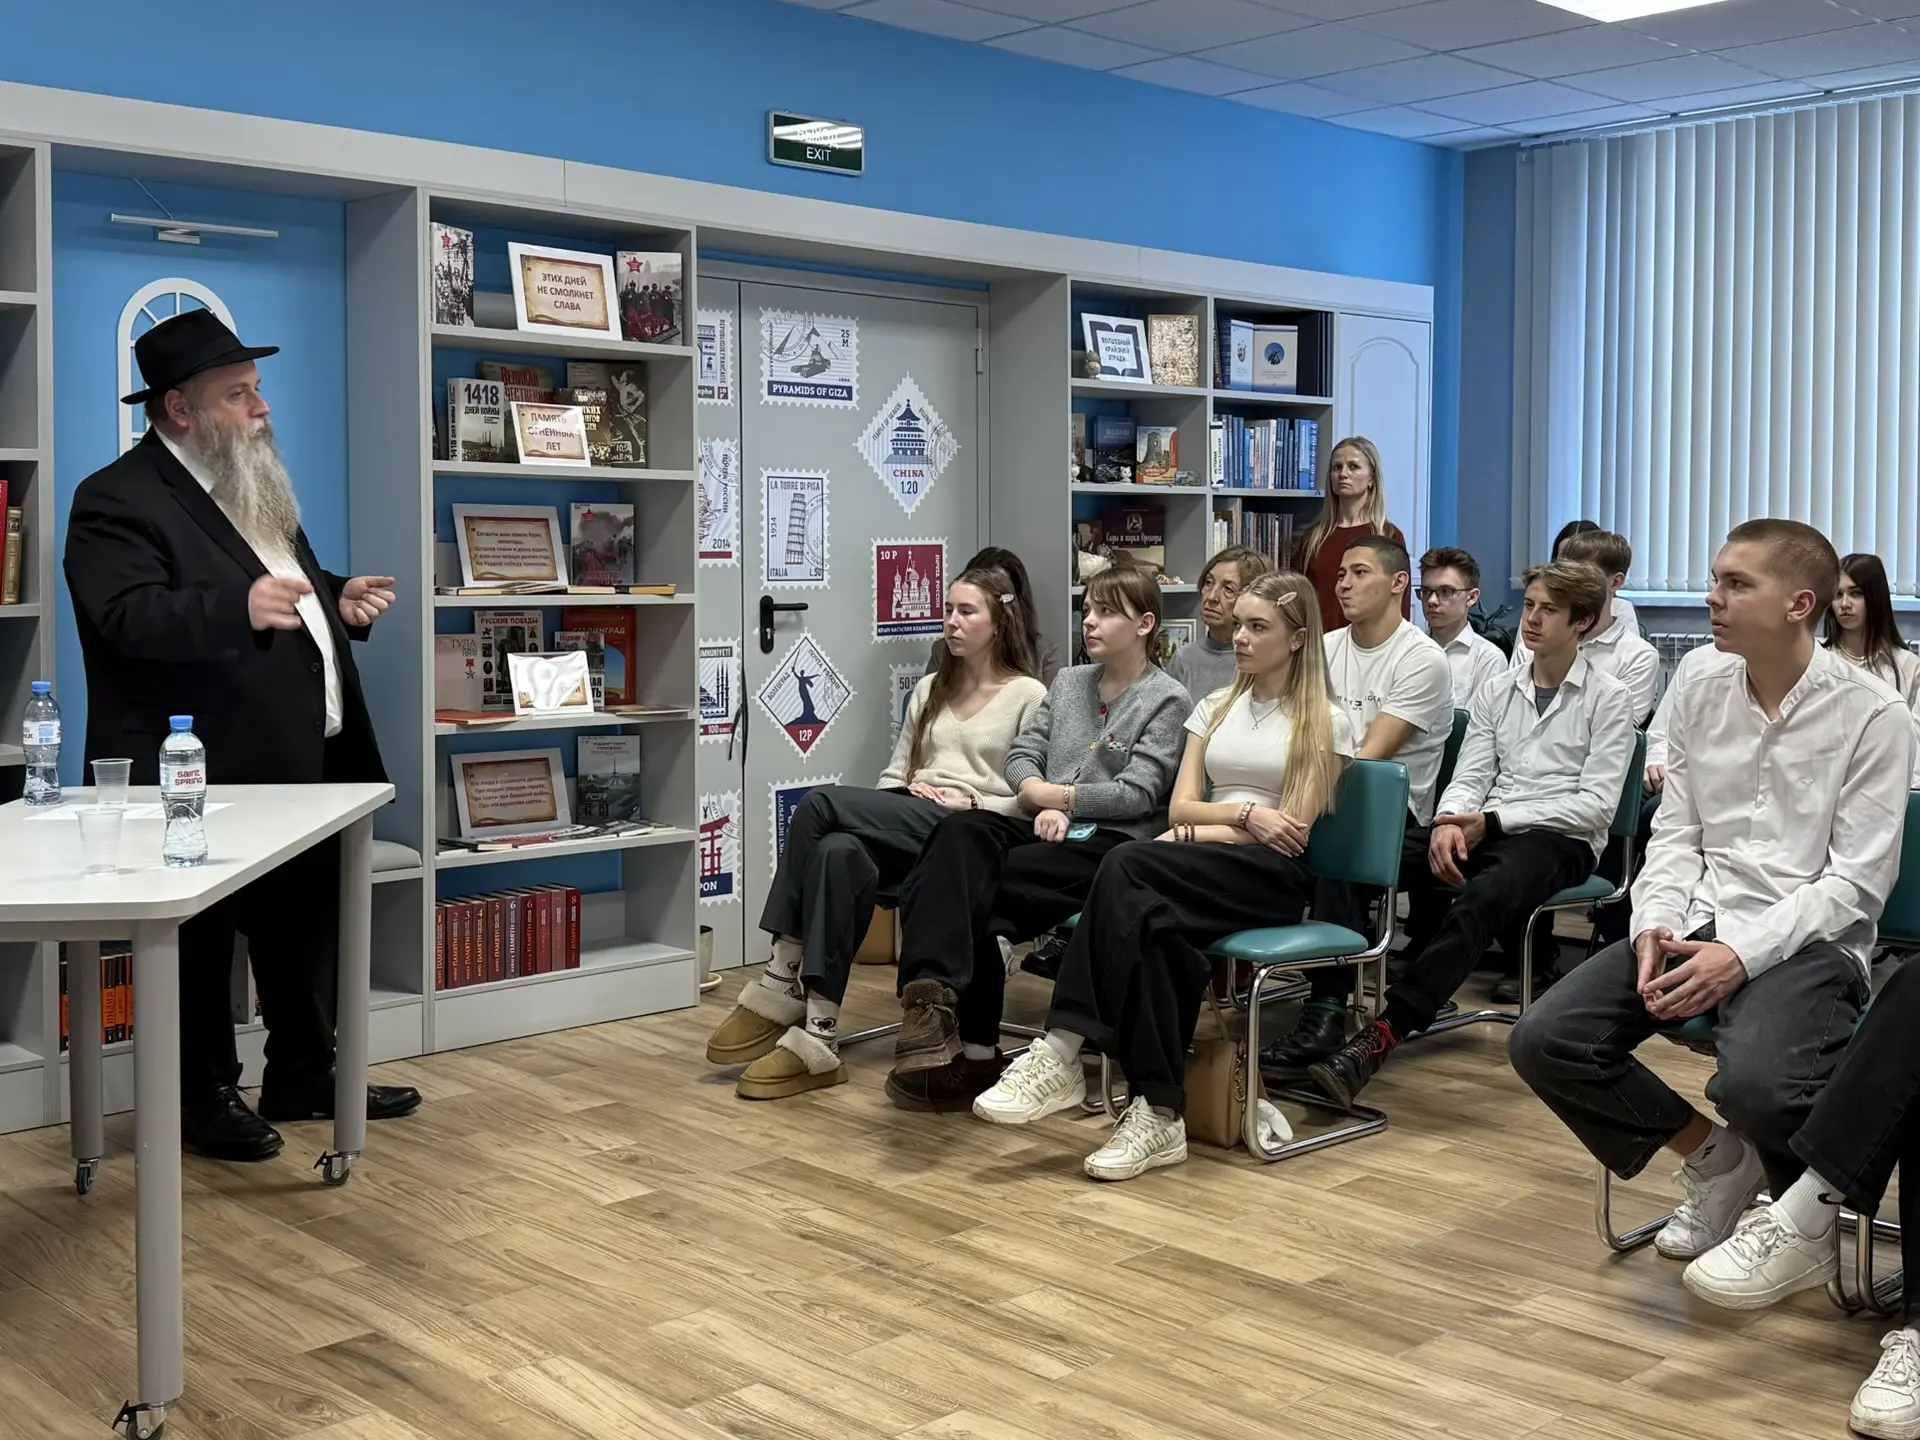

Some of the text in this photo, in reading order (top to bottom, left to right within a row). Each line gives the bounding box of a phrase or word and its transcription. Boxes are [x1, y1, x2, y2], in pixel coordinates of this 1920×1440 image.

[806, 146, 832, 161] EXIT
[541, 273, 587, 286] ЭТИХ ДНЕЙ
[537, 285, 594, 300] НЕ СМОЛКНЕТ
[554, 300, 581, 311] СЛАВА
[841, 330, 850, 338] 25
[500, 366, 539, 386] ВЕЛИКАЯ
[464, 383, 499, 406] 1418
[772, 384, 848, 398] PYRAMIDS OF GIZA
[464, 406, 500, 416] ДНЕЙ ВОЙНЫ
[531, 412, 567, 424] ПАМЯТЬ
[546, 441, 561, 451] ЛЕТ
[893, 469, 925, 478] CHINA
[770, 480, 820, 491] LA TORRE DI PISA
[900, 481, 918, 494] 1.20
[712, 538, 731, 550] 2014
[880, 550, 898, 560] 10 Р
[769, 567, 788, 577] ITALIA
[480, 617, 539, 625] РУССКИЕ ПОБЕДЫ
[572, 626, 625, 635] СТАЛИНГРАД
[450, 639, 477, 649] ТУЛА
[899, 676, 910, 690] 50
[708, 724, 719, 734] 100
[799, 729, 813, 742] 12Р
[526, 899, 533, 909] 6
[571, 895, 577, 904] 8
[495, 902, 500, 910] 5
[510, 900, 516, 910] 6
[464, 910, 471, 920] 3
[476, 909, 483, 918] 4
